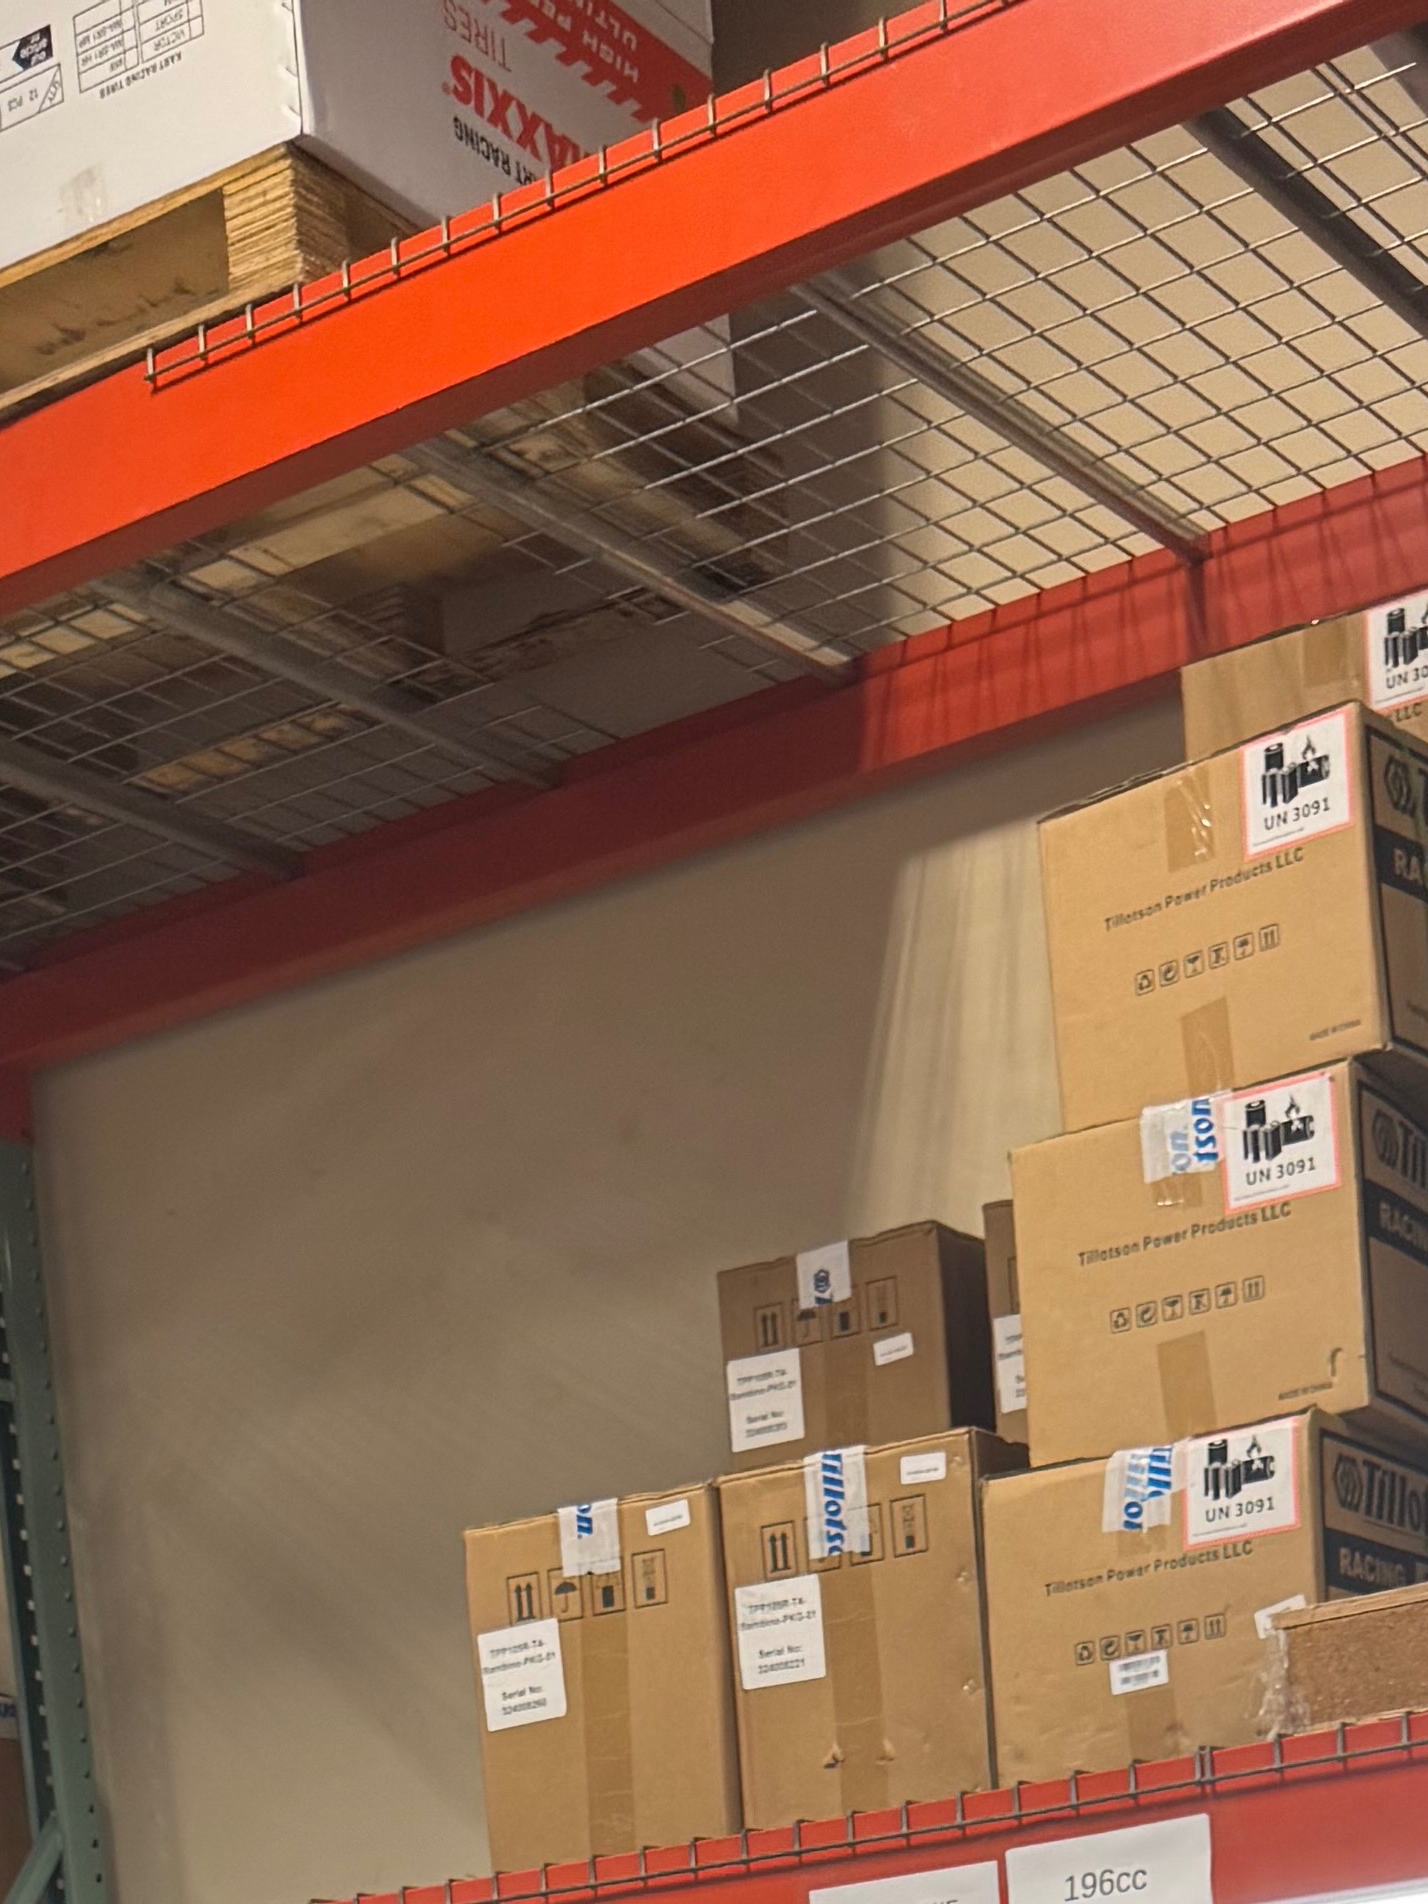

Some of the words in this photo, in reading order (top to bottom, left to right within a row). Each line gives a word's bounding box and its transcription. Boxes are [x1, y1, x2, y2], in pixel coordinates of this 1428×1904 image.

[1385, 668, 1409, 690] UN
[1264, 810, 1289, 831] UN
[1293, 797, 1330, 823] 3091
[1103, 901, 1163, 932] Tillotson
[1164, 883, 1208, 911] Power
[1209, 861, 1274, 893] Products
[1274, 846, 1305, 871] LLC
[1246, 1169, 1271, 1187] UN
[1277, 1157, 1316, 1180] 3091
[1078, 1241, 1141, 1267] Tillotson
[1143, 1226, 1189, 1251] Power
[1191, 1211, 1258, 1239] Products
[1261, 1201, 1291, 1222] LLC
[1205, 1504, 1230, 1524] UN
[1235, 1497, 1274, 1518] 3091
[1045, 1571, 1103, 1597] Tillotson
[1106, 1562, 1151, 1583] Power
[1154, 1549, 1219, 1572] Products
[1223, 1540, 1253, 1559] LLC
[1339, 1546, 1406, 1588] RACING
[759, 1647, 782, 1660] Serial
[501, 1688, 526, 1703] Serial
[1063, 1868, 1148, 1902] 196cc
